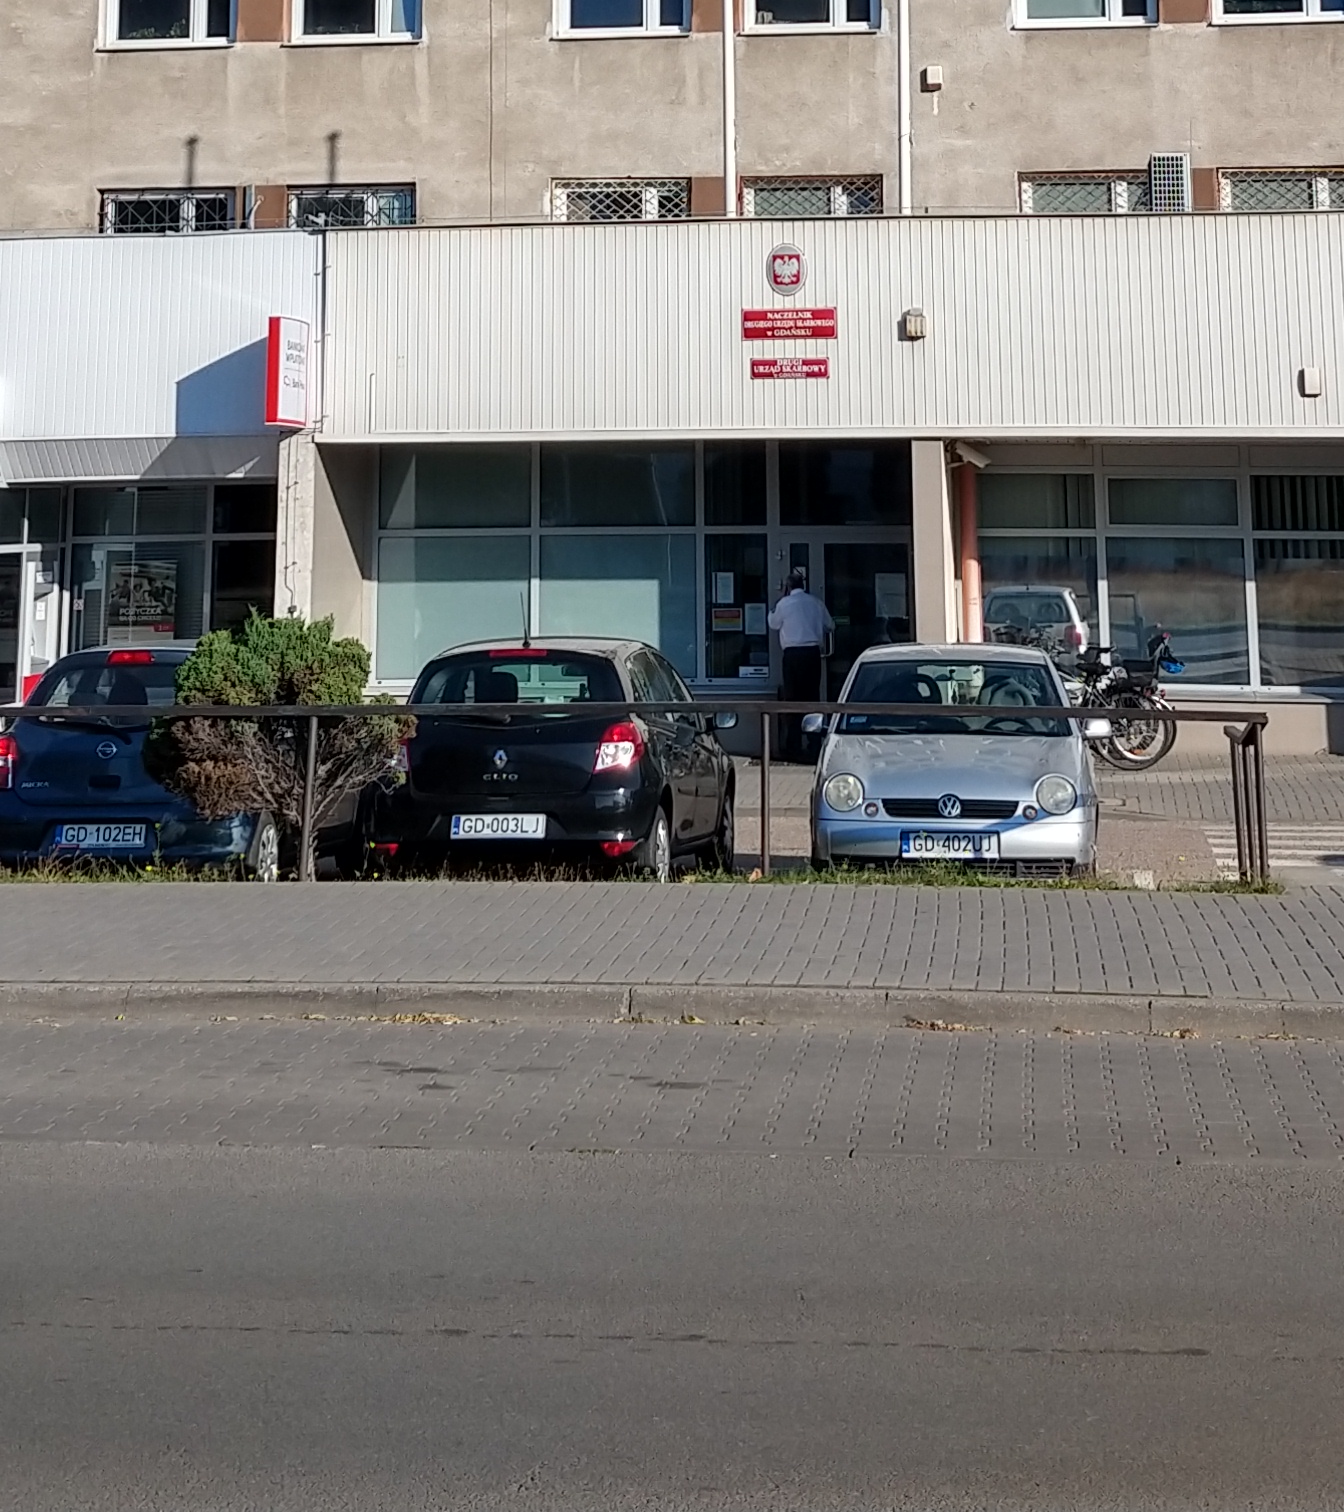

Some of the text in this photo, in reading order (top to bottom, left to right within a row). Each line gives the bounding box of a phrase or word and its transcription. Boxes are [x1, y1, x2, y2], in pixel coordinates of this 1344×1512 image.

[766, 311, 813, 320] NACZELNIK
[744, 320, 773, 328] DRUGIEGO
[796, 319, 834, 327] SKARBOWEGO
[774, 328, 813, 336] GDAŃSKU
[754, 365, 826, 374] URZĄD SKARBOWY
[482, 773, 519, 781] CLIO
[462, 817, 540, 834] GD 003LJ
[64, 826, 143, 843] GD 102EH
[913, 834, 991, 852] GD 402UJ
